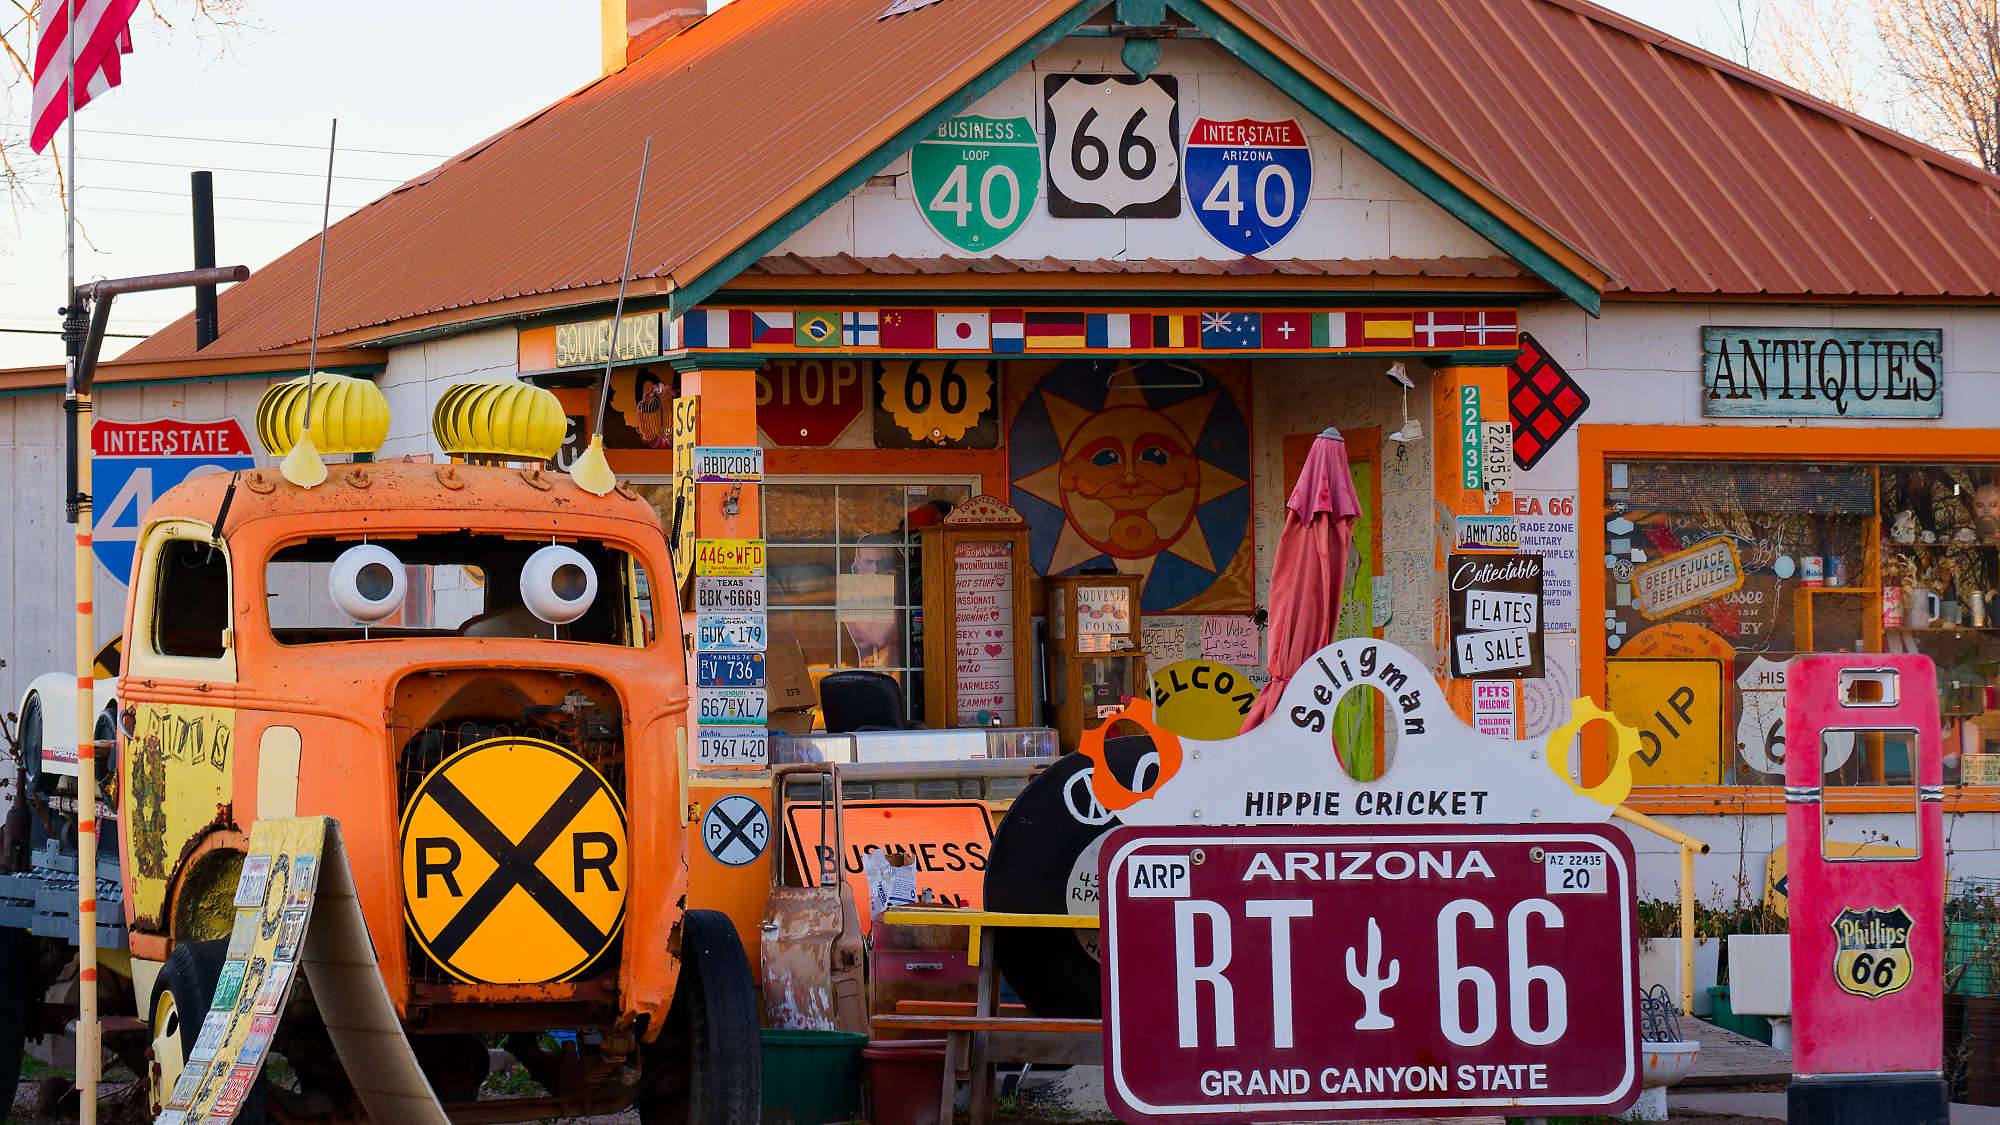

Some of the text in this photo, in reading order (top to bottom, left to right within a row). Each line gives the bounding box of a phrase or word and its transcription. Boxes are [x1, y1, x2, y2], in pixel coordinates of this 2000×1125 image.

[938, 121, 1014, 139] BUSINESS
[1203, 125, 1290, 143] INTERSTATE
[1071, 107, 1156, 180] 66
[962, 150, 989, 160] LOOP
[1222, 150, 1273, 161] ARIZONA
[929, 165, 1020, 228] 40
[1202, 165, 1294, 227] 40
[557, 315, 655, 367] SOUVENIRS
[756, 360, 857, 406] STOP
[1709, 338, 1936, 415] ANTIQUES
[905, 361, 967, 414] 66
[103, 430, 229, 452] INTERSTATE
[1464, 388, 1478, 488] 22435
[1489, 426, 1506, 473] 22435
[704, 456, 759, 474] BBD2081
[1514, 498, 1543, 516] EA
[1549, 498, 1573, 516] 66
[1466, 525, 1517, 542] AMM7386
[1520, 523, 1573, 532] RADE ZONE
[1519, 536, 1562, 545] -MILITARY
[700, 547, 761, 564] 446 WFD
[1452, 560, 1540, 591] Collectable
[1646, 550, 1725, 590] BEETLEJUICE
[956, 578, 996, 588] HOT STUFF
[1652, 565, 1731, 605] BEETLEJUICE
[700, 590, 760, 605] BBK 6669
[956, 596, 996, 605] ASSIONATE
[1078, 589, 1126, 602] SOUVENIR
[956, 613, 989, 622] BURNING
[1472, 599, 1532, 623] PLATES
[702, 627, 761, 642] GUK 179
[956, 630, 979, 639] SEXY
[1085, 622, 1120, 631] COINS
[1544, 622, 1572, 631] ELCOME!!
[1141, 629, 1185, 645] MBRELLAS
[957, 648, 979, 656] WILD
[1466, 637, 1526, 664] 4 SALE
[727, 662, 753, 679] 736
[957, 664, 981, 672] MILD
[957, 681, 1000, 690] HARMLESS
[1760, 672, 1785, 684] HIS
[1146, 666, 1256, 716] ELCOM
[1291, 646, 1425, 735] Seligman
[1478, 686, 1510, 697] PETS
[702, 698, 764, 717] 667 XL7
[1479, 700, 1510, 709] WELCOME
[1640, 686, 1694, 767] DIP
[702, 740, 765, 757] D 967 420
[1245, 791, 1488, 816] HIPPIE CRICKET
[710, 823, 764, 839] R R
[415, 832, 620, 898] R R
[1242, 850, 1496, 881] ARIZONA
[1551, 856, 1601, 865] AZ 22435
[1133, 864, 1185, 888] ARP
[1563, 868, 1590, 888] 20
[1840, 919, 1905, 949] Phillips
[1174, 898, 1567, 1048] RT 66
[1852, 953, 1896, 988] 66
[1200, 1063, 1548, 1096] GRAND CANYON STATE
